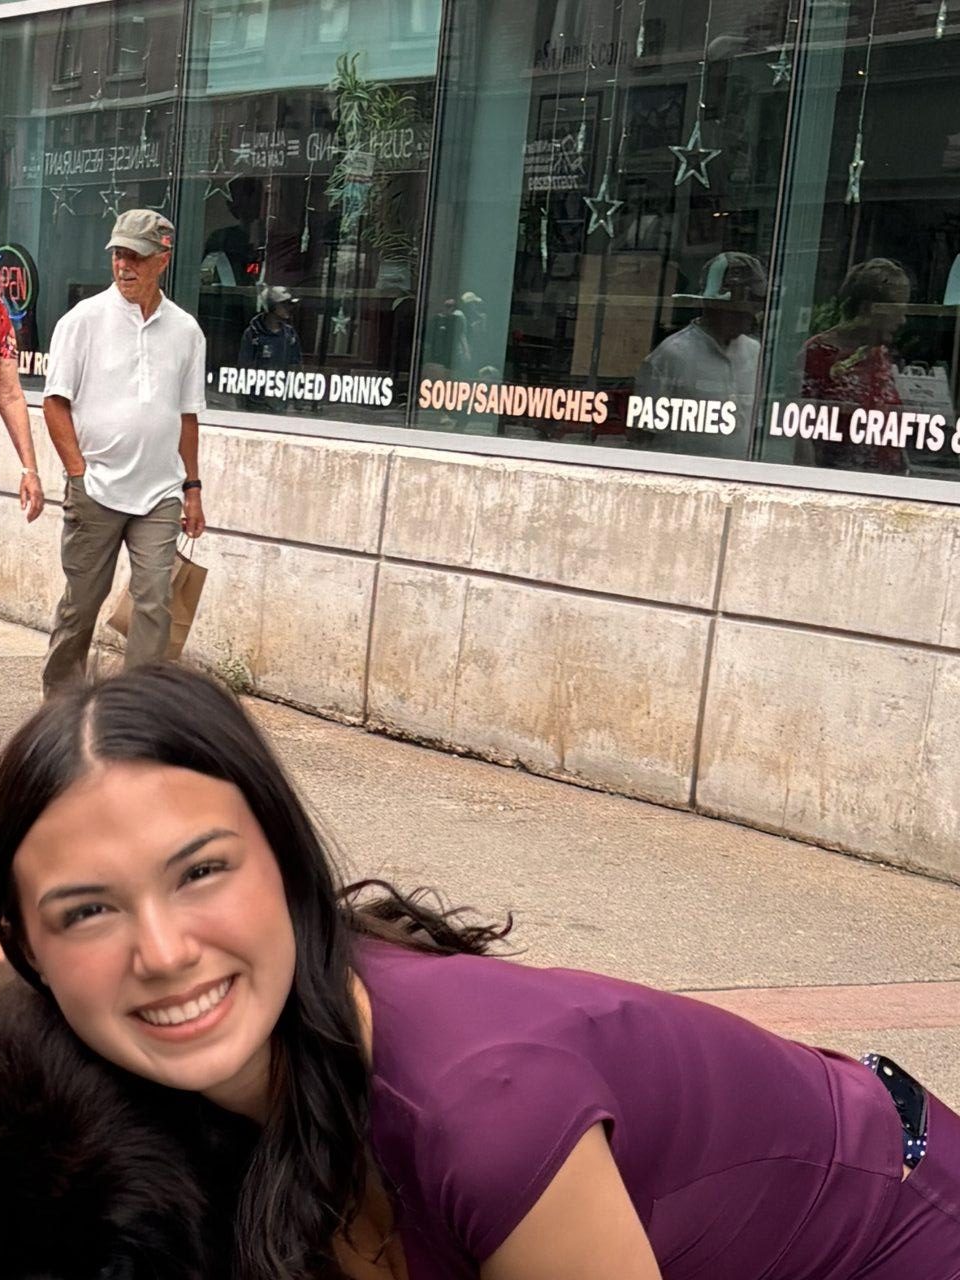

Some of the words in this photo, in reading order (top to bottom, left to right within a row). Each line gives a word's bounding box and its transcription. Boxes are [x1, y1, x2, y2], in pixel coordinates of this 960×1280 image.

[218, 367, 325, 400] FRAPPES/ICED
[329, 375, 393, 406] DRINKS
[419, 378, 608, 424] SOUP/SANDWICHES
[626, 395, 736, 435] PASTRIES
[770, 402, 842, 442] LOCAL
[849, 408, 946, 452] CRAFTS
